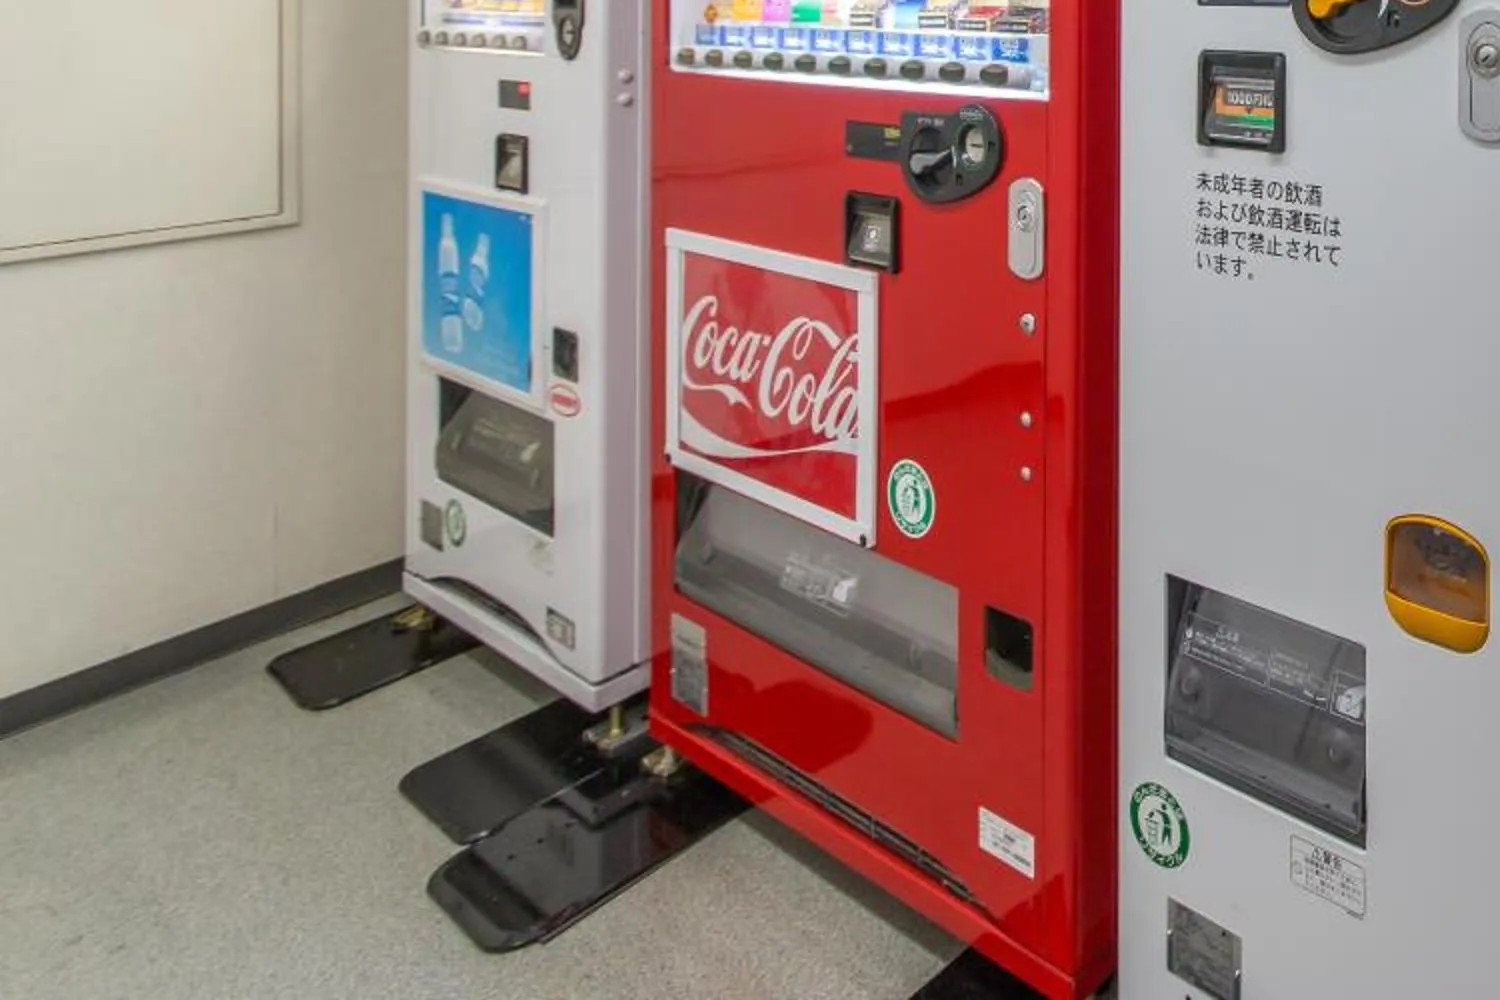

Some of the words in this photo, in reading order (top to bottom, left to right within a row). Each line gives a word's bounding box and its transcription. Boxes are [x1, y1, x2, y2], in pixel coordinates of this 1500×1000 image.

[1196, 172, 1323, 207] 未成年者の飲酒
[1196, 199, 1342, 238] および飲酒運転は
[1194, 223, 1341, 267] 法律で禁止されて
[1196, 253, 1254, 281] います。
[681, 295, 860, 440] Coca-Cola
